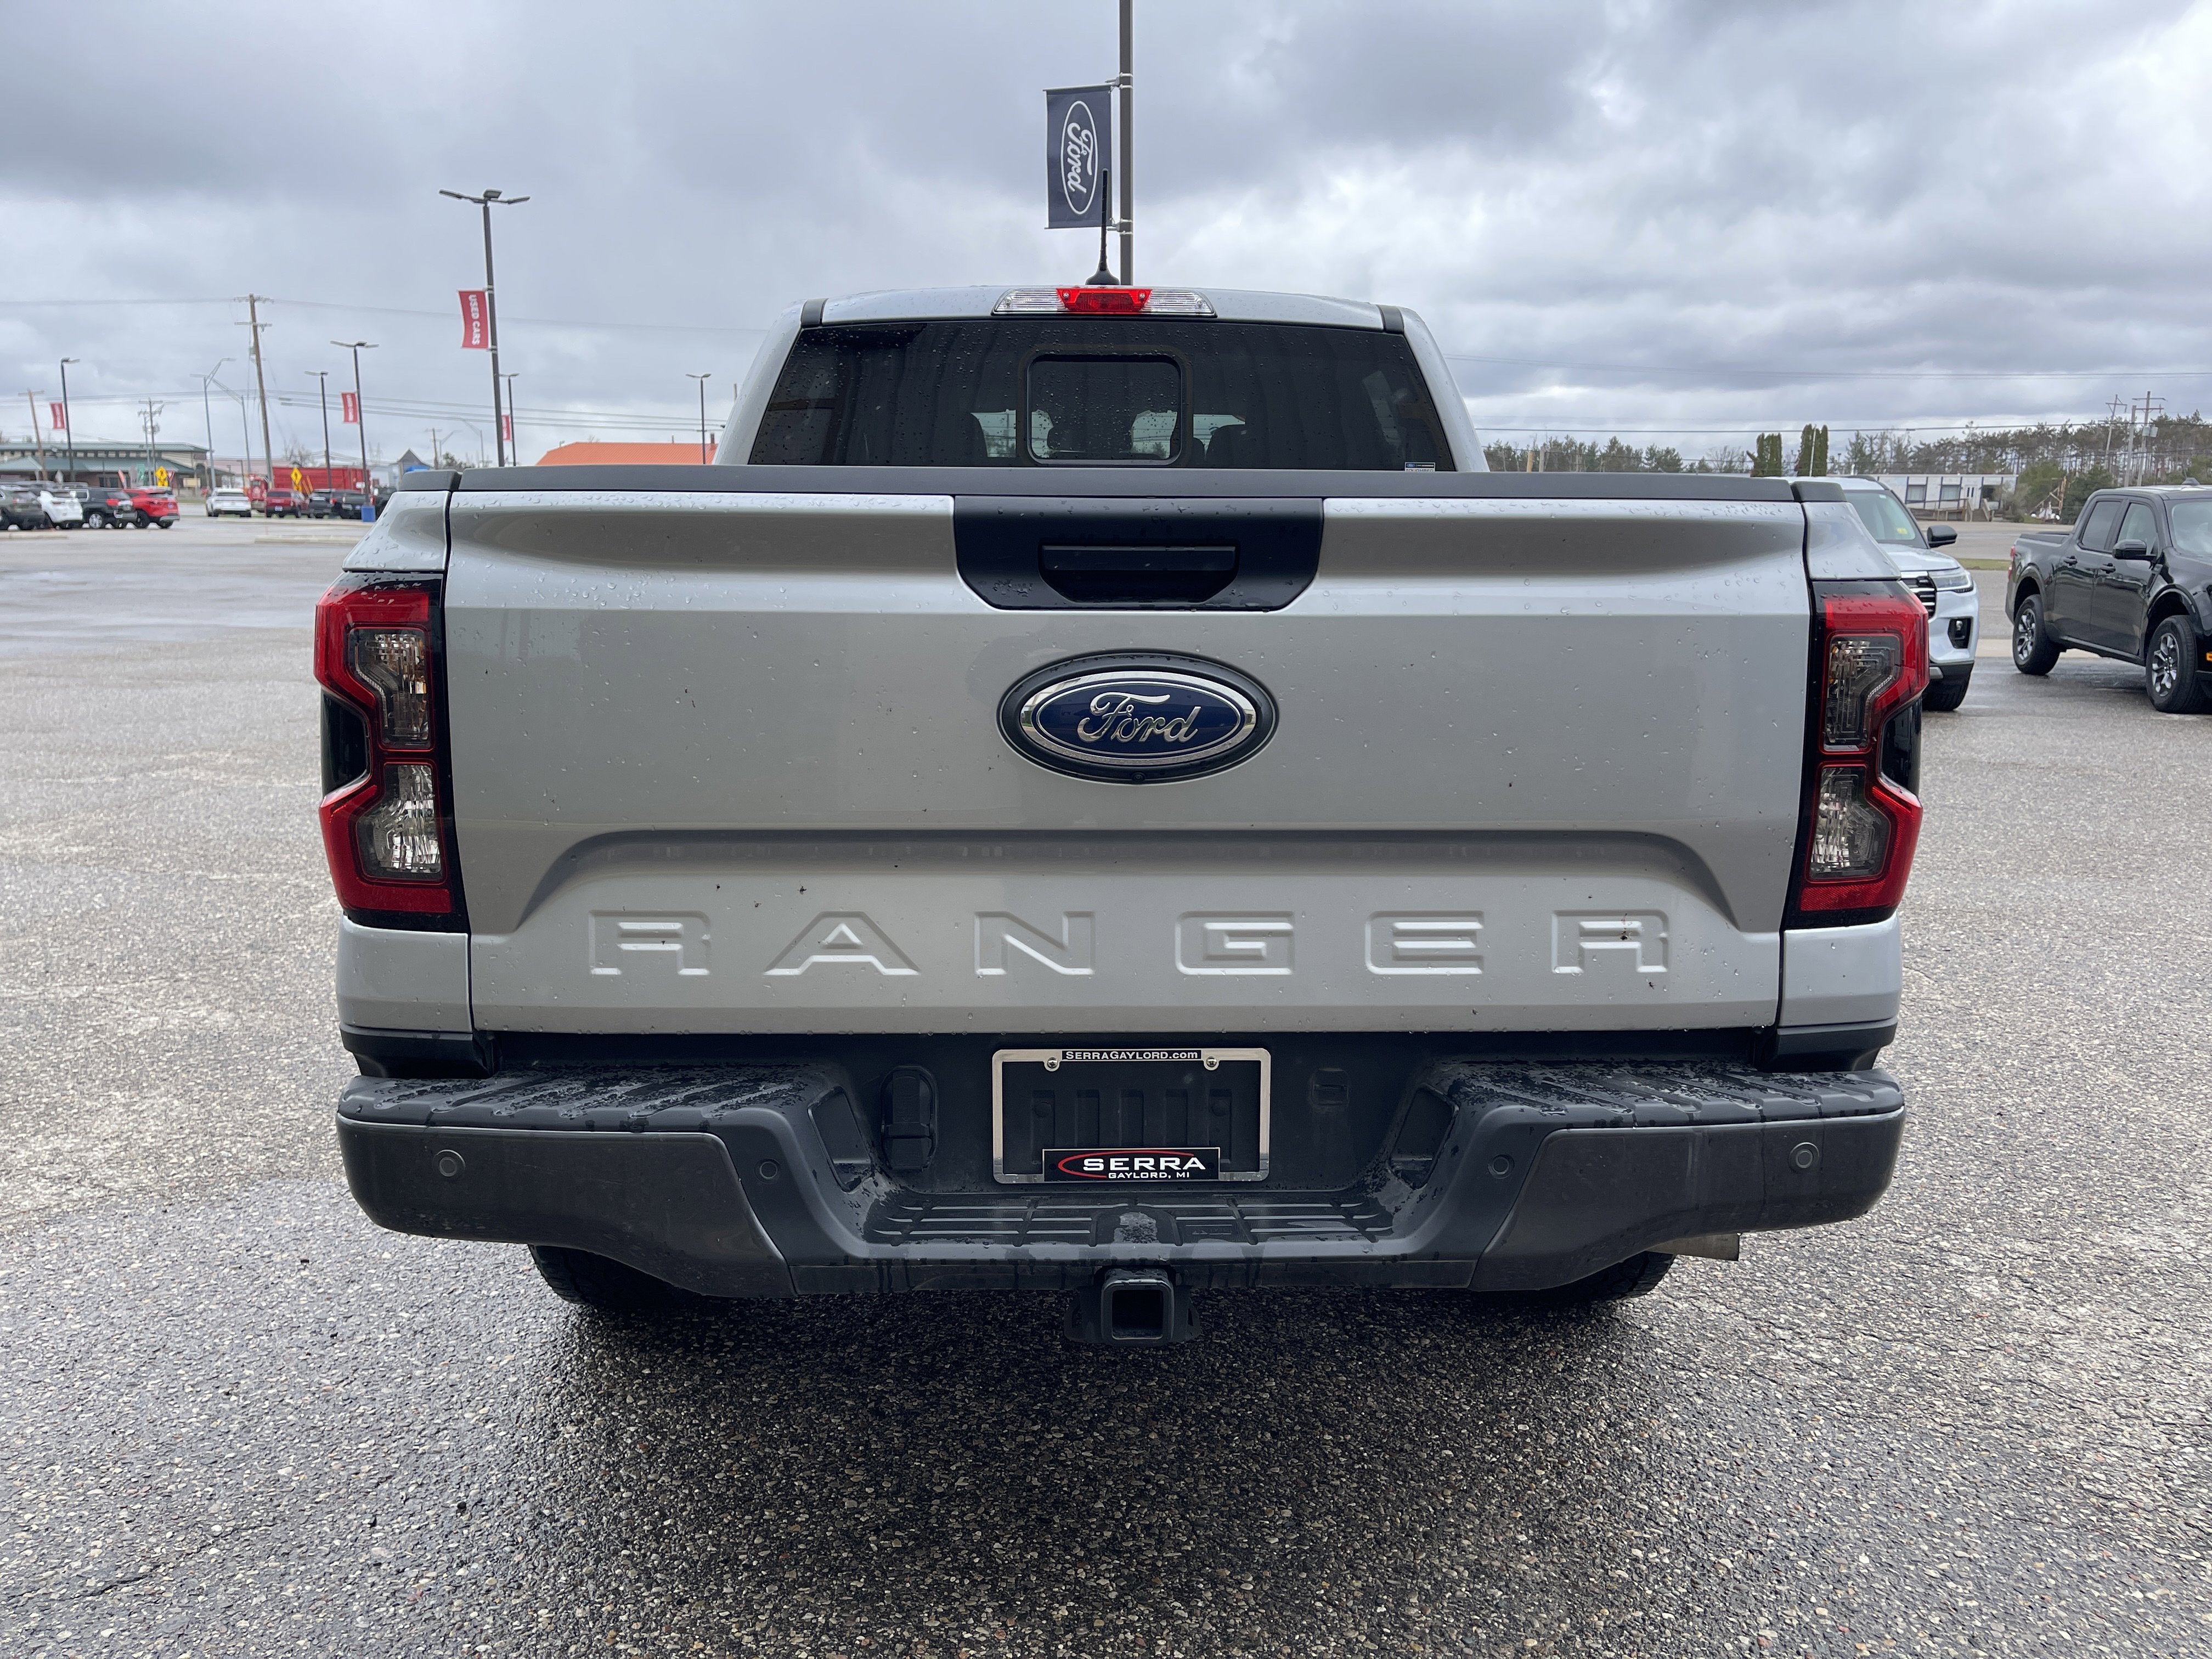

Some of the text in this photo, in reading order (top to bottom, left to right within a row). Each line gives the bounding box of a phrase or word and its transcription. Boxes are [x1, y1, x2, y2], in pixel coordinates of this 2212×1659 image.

[1067, 122, 1093, 193] Ford
[469, 295, 479, 319] USED
[1077, 692, 1201, 742] Ford
[589, 909, 1668, 975] RANGER
[1066, 1051, 1198, 1059] SERRAGAYLORD.com
[1083, 1157, 1205, 1171] SERRA
